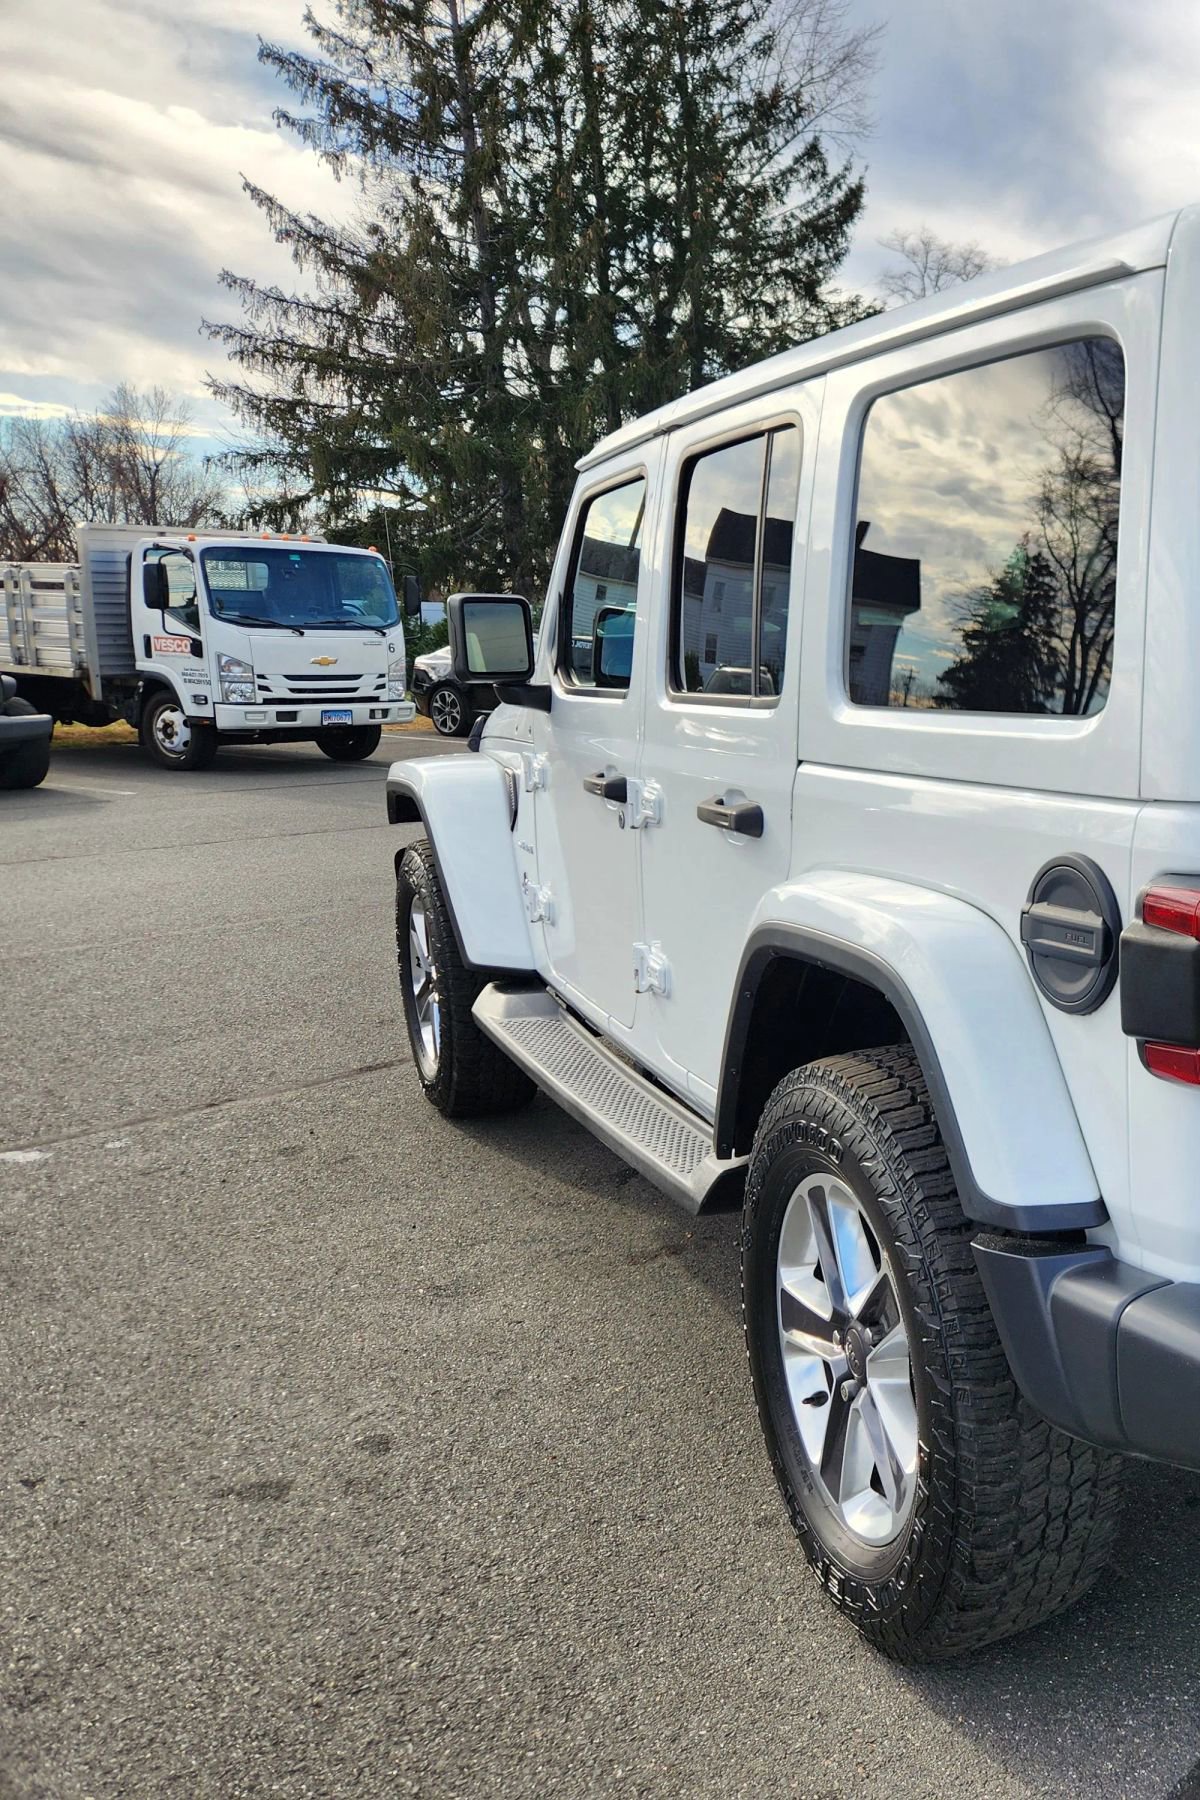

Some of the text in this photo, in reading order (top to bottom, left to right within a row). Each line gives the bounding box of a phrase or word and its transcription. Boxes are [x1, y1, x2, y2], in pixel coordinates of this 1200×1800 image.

[154, 638, 191, 653] VESCO
[388, 643, 396, 653] 6
[1065, 932, 1089, 946] FUEL
